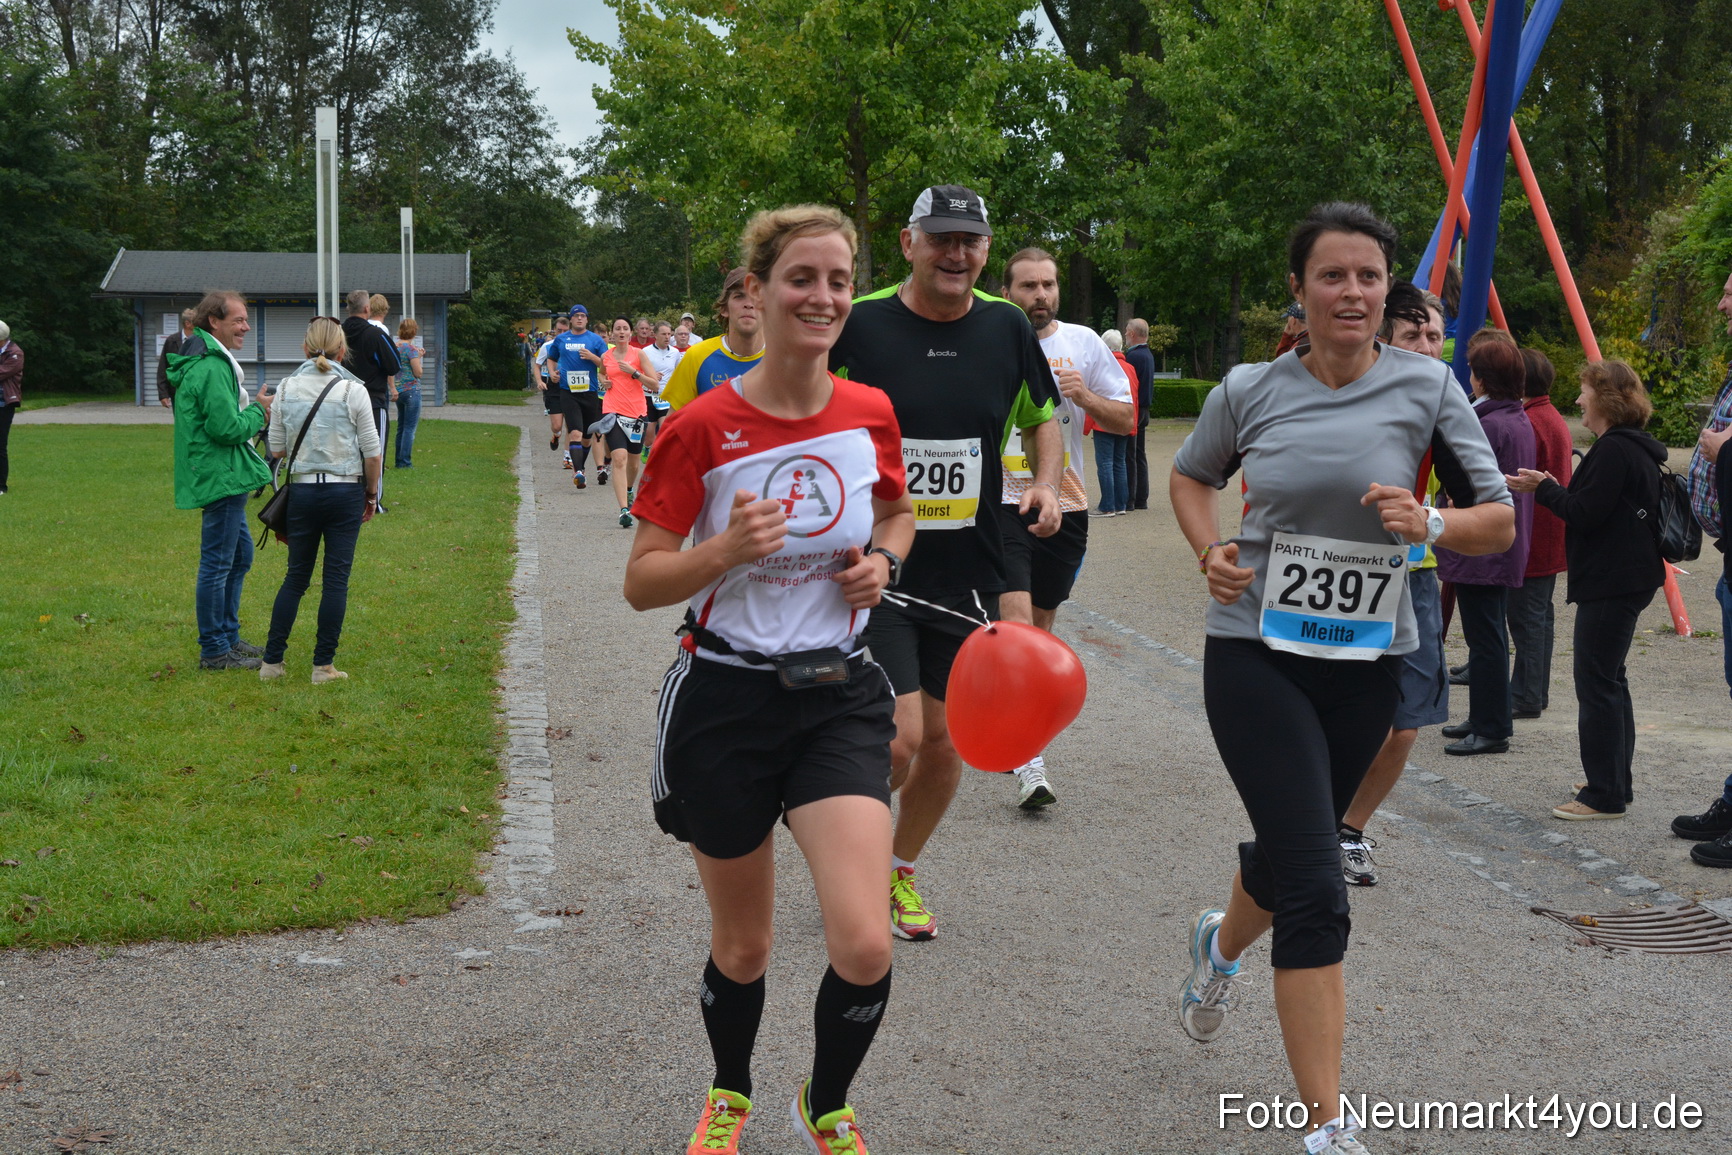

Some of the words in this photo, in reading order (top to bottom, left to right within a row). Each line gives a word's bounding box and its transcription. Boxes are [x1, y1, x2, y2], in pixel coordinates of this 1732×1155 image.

[1047, 357, 1063, 367] tal
[571, 376, 585, 384] 311
[721, 440, 749, 450] erima
[902, 448, 921, 457] RTL
[924, 449, 967, 458] Neumarkt
[907, 462, 965, 495] 296
[917, 504, 950, 517] Horst
[799, 552, 826, 561] MIT
[1274, 543, 1319, 560] PARTL
[1322, 550, 1384, 566] Neumarkt
[1278, 563, 1392, 615] 2397
[1300, 621, 1355, 643] Meitta
